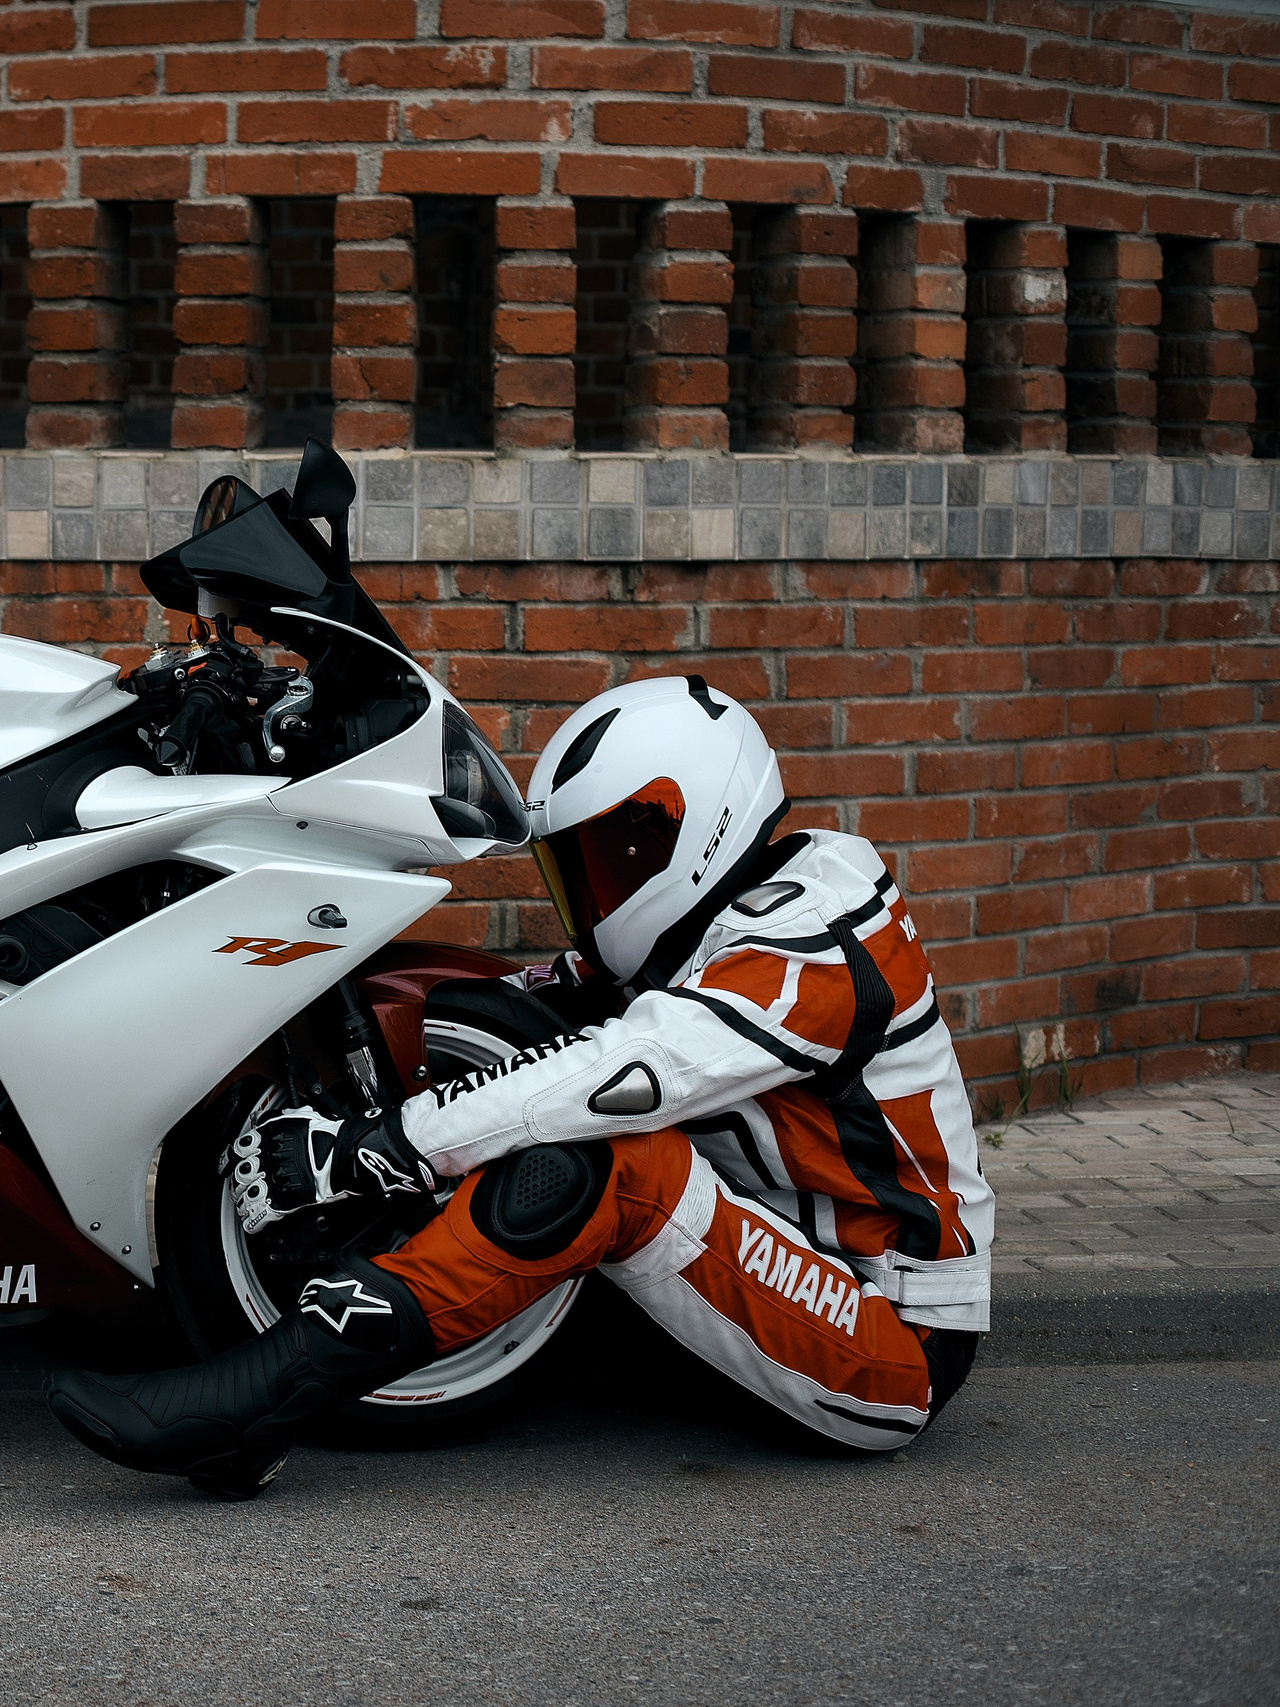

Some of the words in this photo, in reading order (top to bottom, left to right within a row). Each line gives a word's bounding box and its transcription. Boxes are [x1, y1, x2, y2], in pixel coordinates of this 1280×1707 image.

[691, 806, 732, 886] LS2
[213, 936, 346, 966] R1
[429, 1035, 593, 1109] YAMAHA
[738, 1218, 861, 1337] YAMAHA
